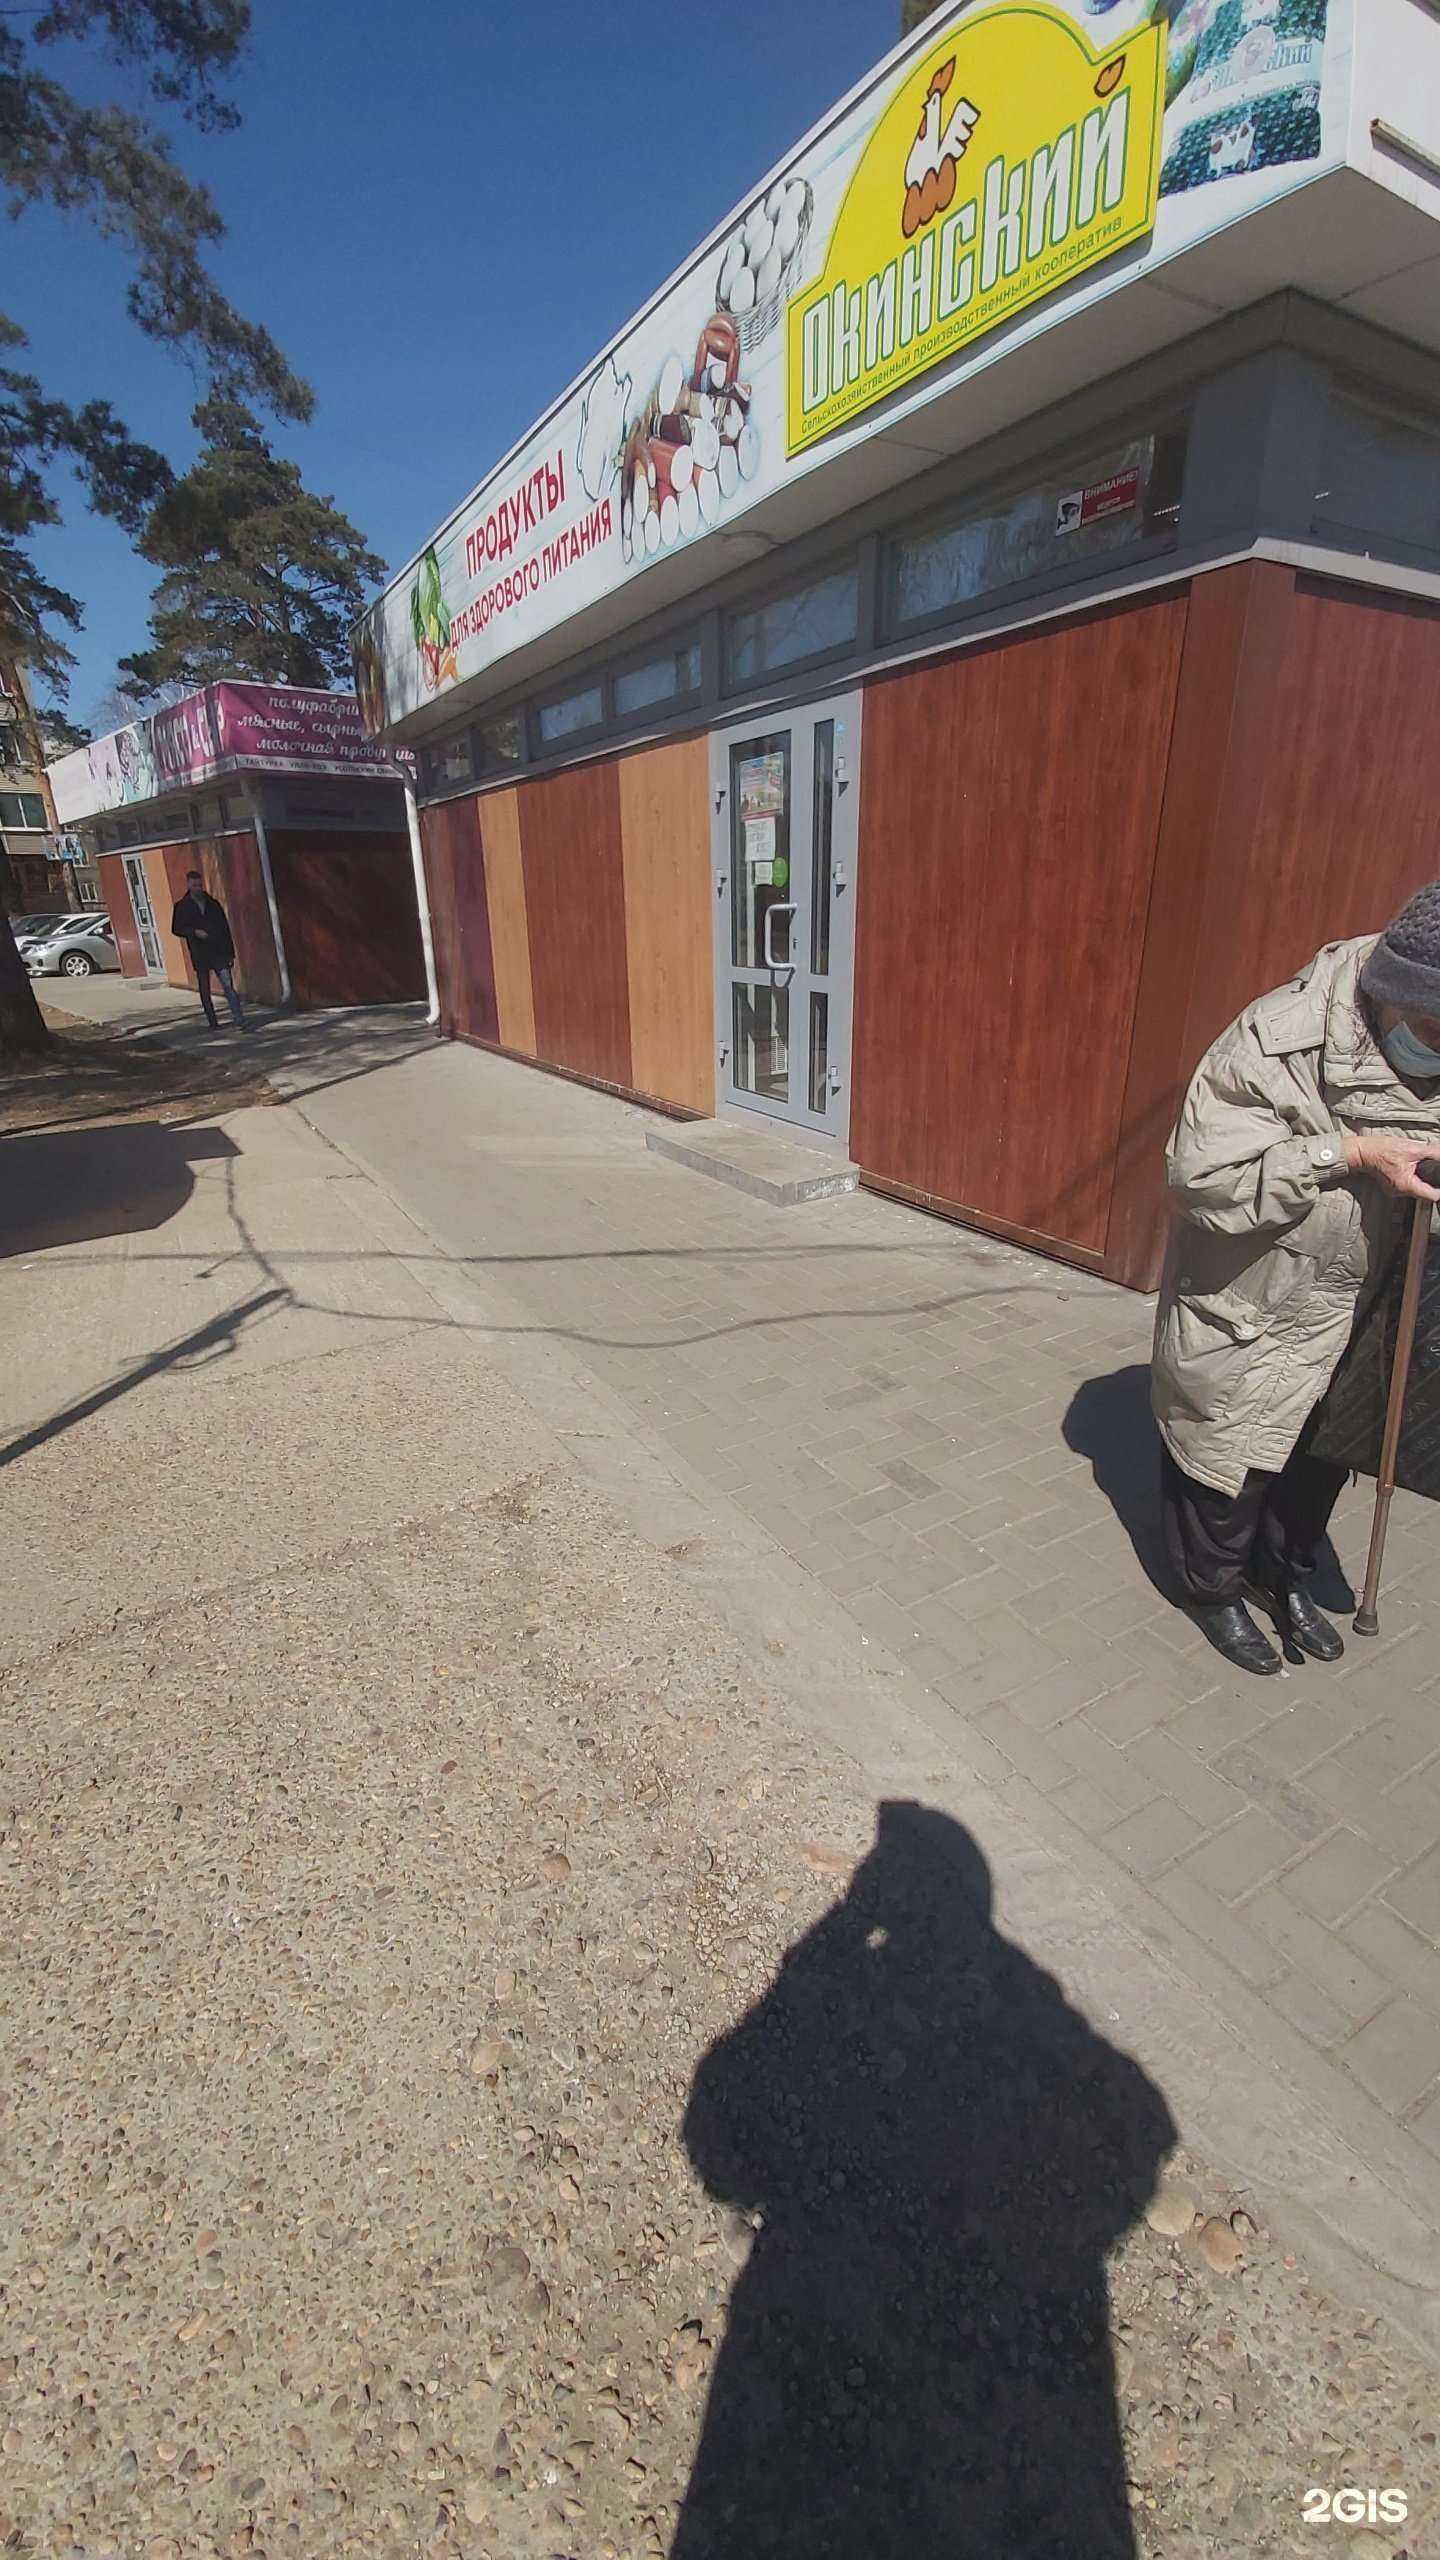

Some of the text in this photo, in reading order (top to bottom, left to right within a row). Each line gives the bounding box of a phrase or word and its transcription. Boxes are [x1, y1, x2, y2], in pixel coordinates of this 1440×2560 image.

[801, 215, 1124, 434] Сельскохозяйственный производственный кооператив
[450, 497, 613, 651] ДЛЯ ЗДОРОВОГО ПИТАНИЯ
[465, 448, 566, 580] ПРОДУКТЫ
